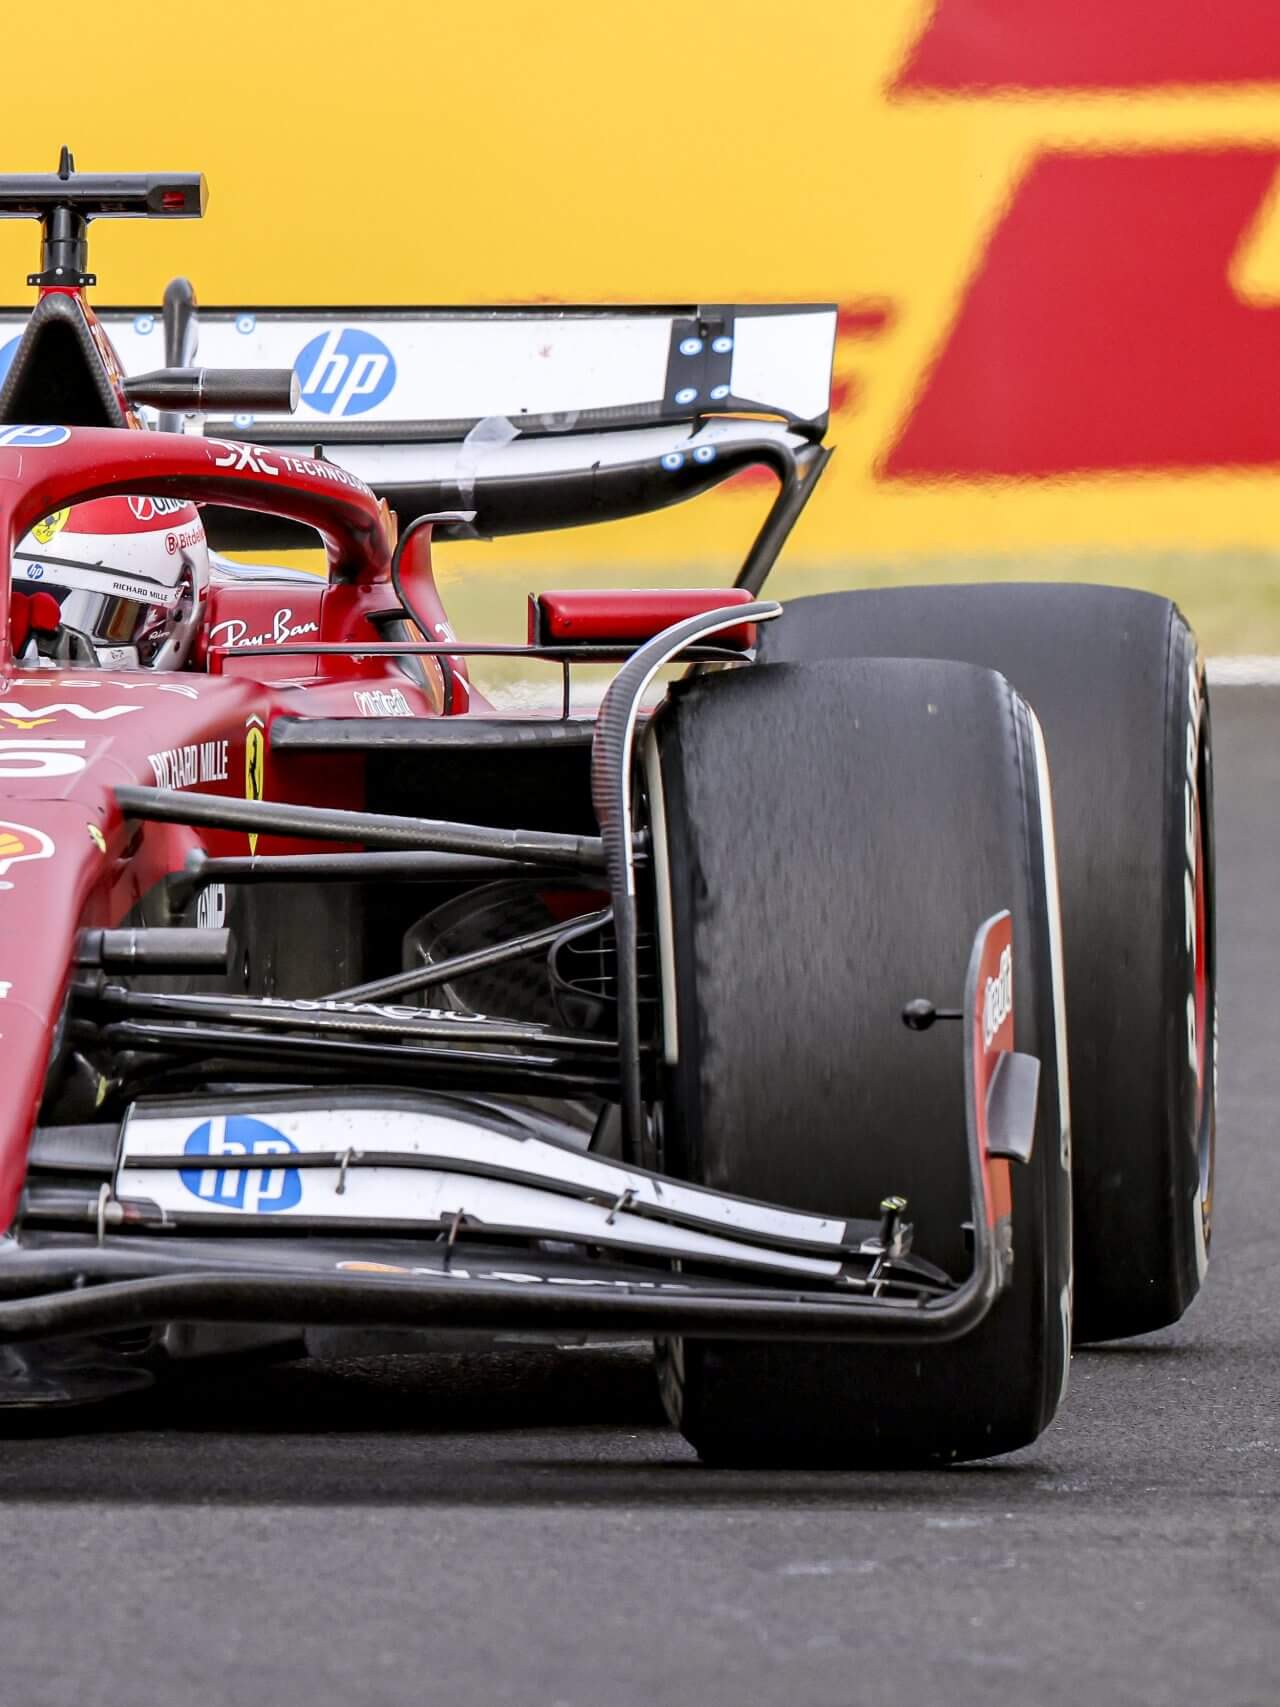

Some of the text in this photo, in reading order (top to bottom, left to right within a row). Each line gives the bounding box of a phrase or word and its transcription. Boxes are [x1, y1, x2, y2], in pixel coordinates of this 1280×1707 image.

[301, 327, 390, 417] hp
[208, 440, 279, 475] DXC
[28, 564, 44, 579] hp
[113, 582, 148, 596] RICHARD
[150, 590, 169, 602] MILLE
[209, 608, 319, 647] Ray-Ban
[147, 740, 228, 792] RICHARD MILLE
[198, 1114, 291, 1212] hp
